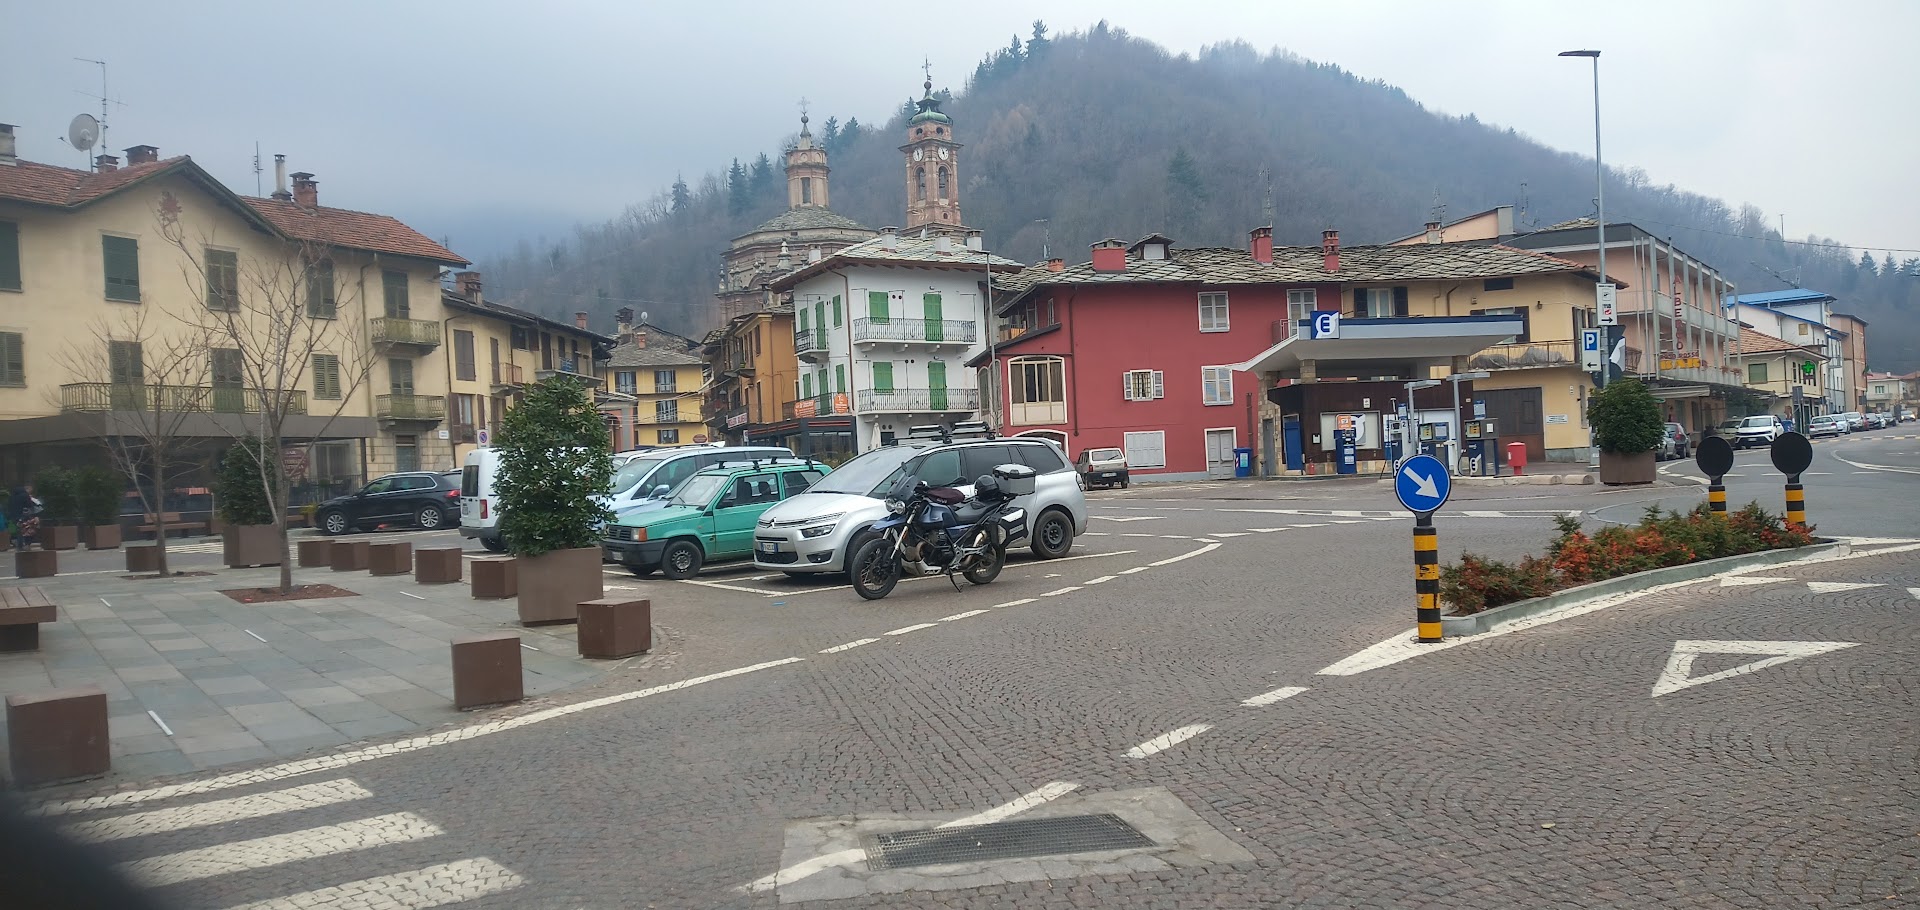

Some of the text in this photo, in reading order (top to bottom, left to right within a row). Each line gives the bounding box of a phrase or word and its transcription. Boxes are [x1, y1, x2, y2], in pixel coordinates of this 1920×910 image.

[1673, 275, 1683, 350] ALBERGO
[1586, 334, 1595, 349] P
[1660, 358, 1700, 370] BAR
